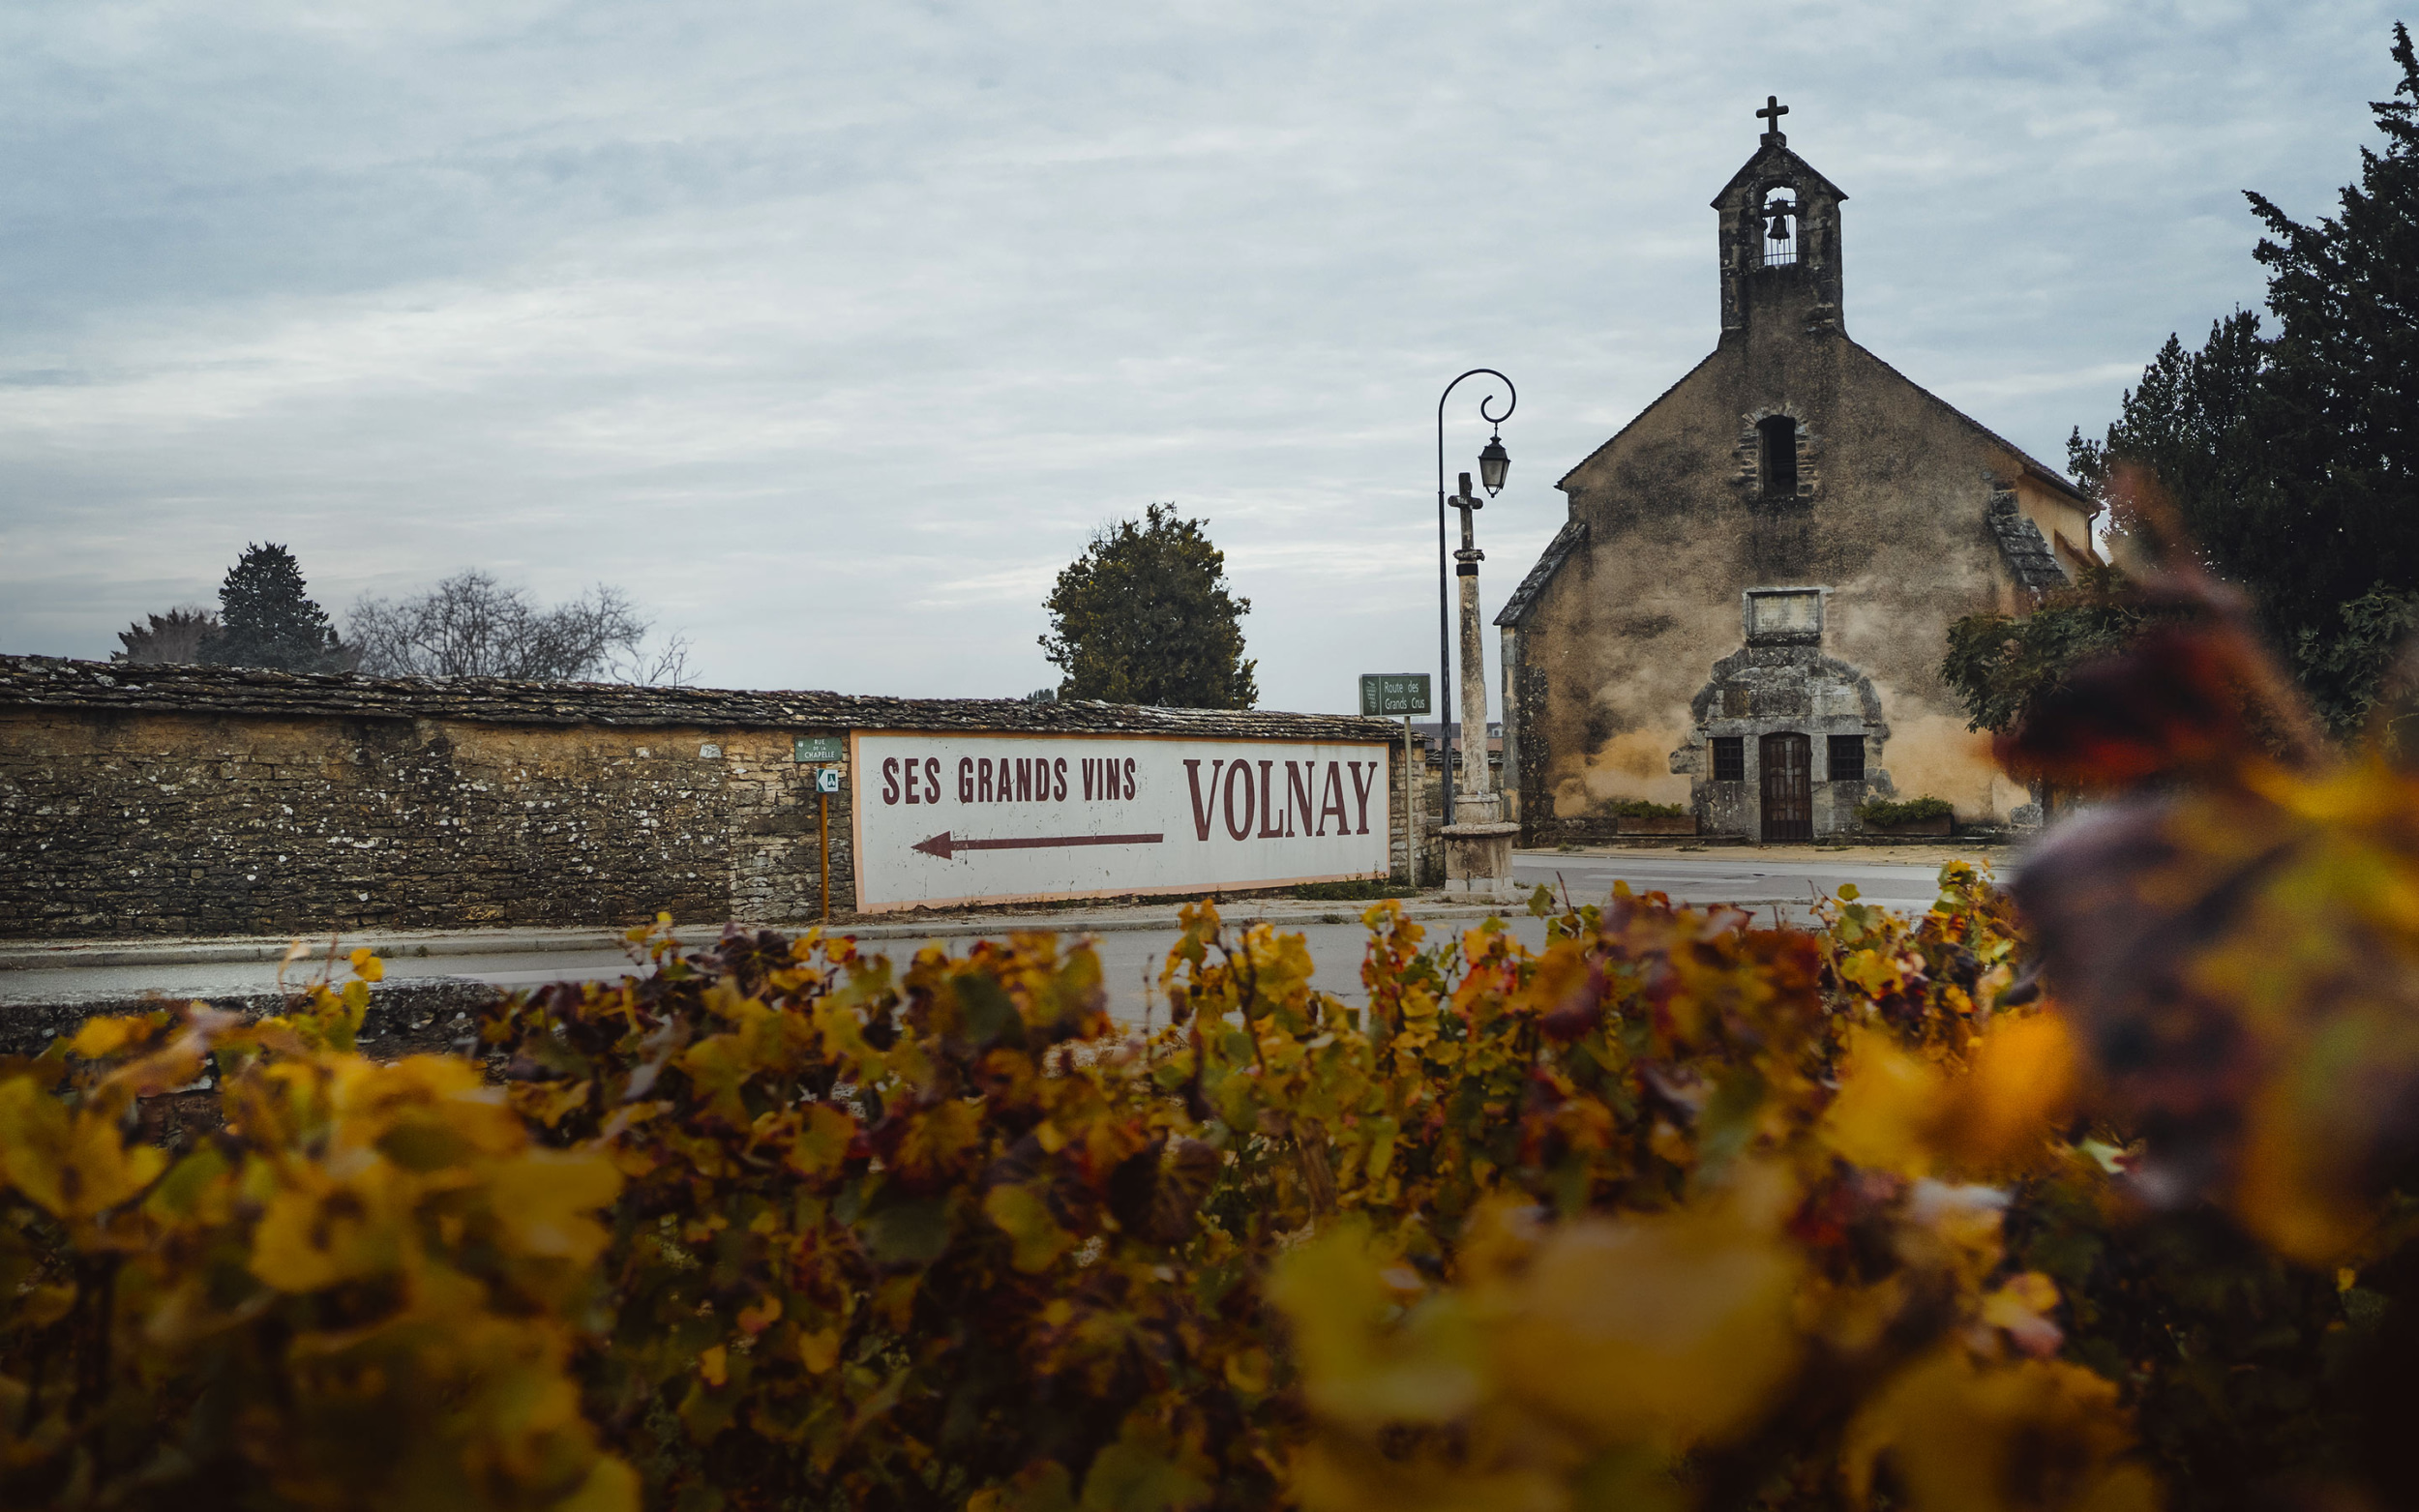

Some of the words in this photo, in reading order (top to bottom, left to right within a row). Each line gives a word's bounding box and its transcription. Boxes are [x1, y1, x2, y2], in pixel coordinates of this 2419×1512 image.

[1384, 681, 1403, 694] Route
[1408, 680, 1419, 693] des
[1385, 697, 1407, 710] Grands
[1411, 697, 1424, 709] Crus
[882, 756, 941, 805] SES
[958, 756, 1067, 804] GRANDS
[1081, 757, 1136, 801] VINS
[1182, 758, 1378, 842] VOLNAY
